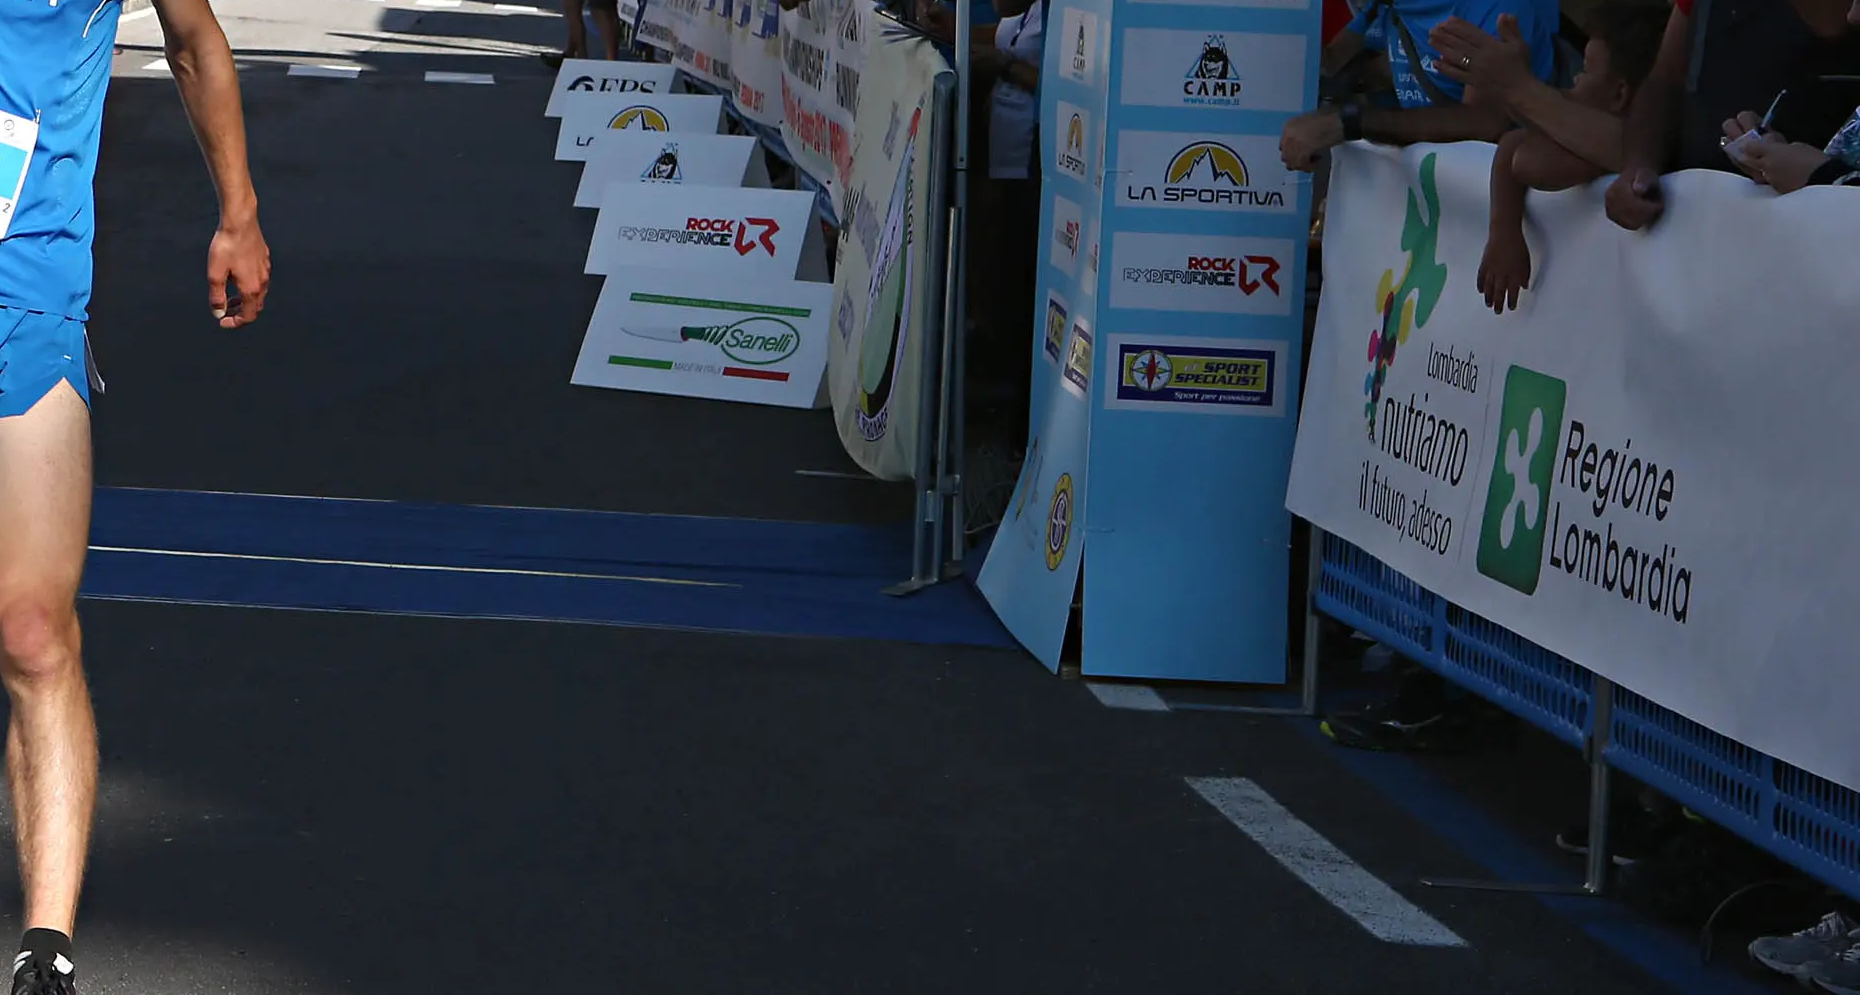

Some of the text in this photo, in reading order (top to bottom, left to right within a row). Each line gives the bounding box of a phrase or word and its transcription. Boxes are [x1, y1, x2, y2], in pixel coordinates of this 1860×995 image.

[1183, 81, 1241, 98] CAMP
[1127, 184, 1285, 207] LA SPORTIVA
[1, 201, 12, 215] 2
[685, 216, 734, 233] ROCK
[617, 225, 733, 248] EXPERIENCE
[1187, 256, 1236, 272] ROCK
[1123, 267, 1236, 287] EXPERIENCE
[725, 328, 794, 354] Sanelli
[1203, 361, 1262, 375] SPORT
[1426, 341, 1479, 394] Lombardia
[1174, 372, 1261, 387] SPECIALIST
[1173, 391, 1261, 403] Sport passione
[1381, 392, 1470, 487] nutriamo
[1559, 420, 1675, 522] Regione
[1358, 461, 1453, 556] il futuro, adesso
[1549, 501, 1693, 624] Lombardia
